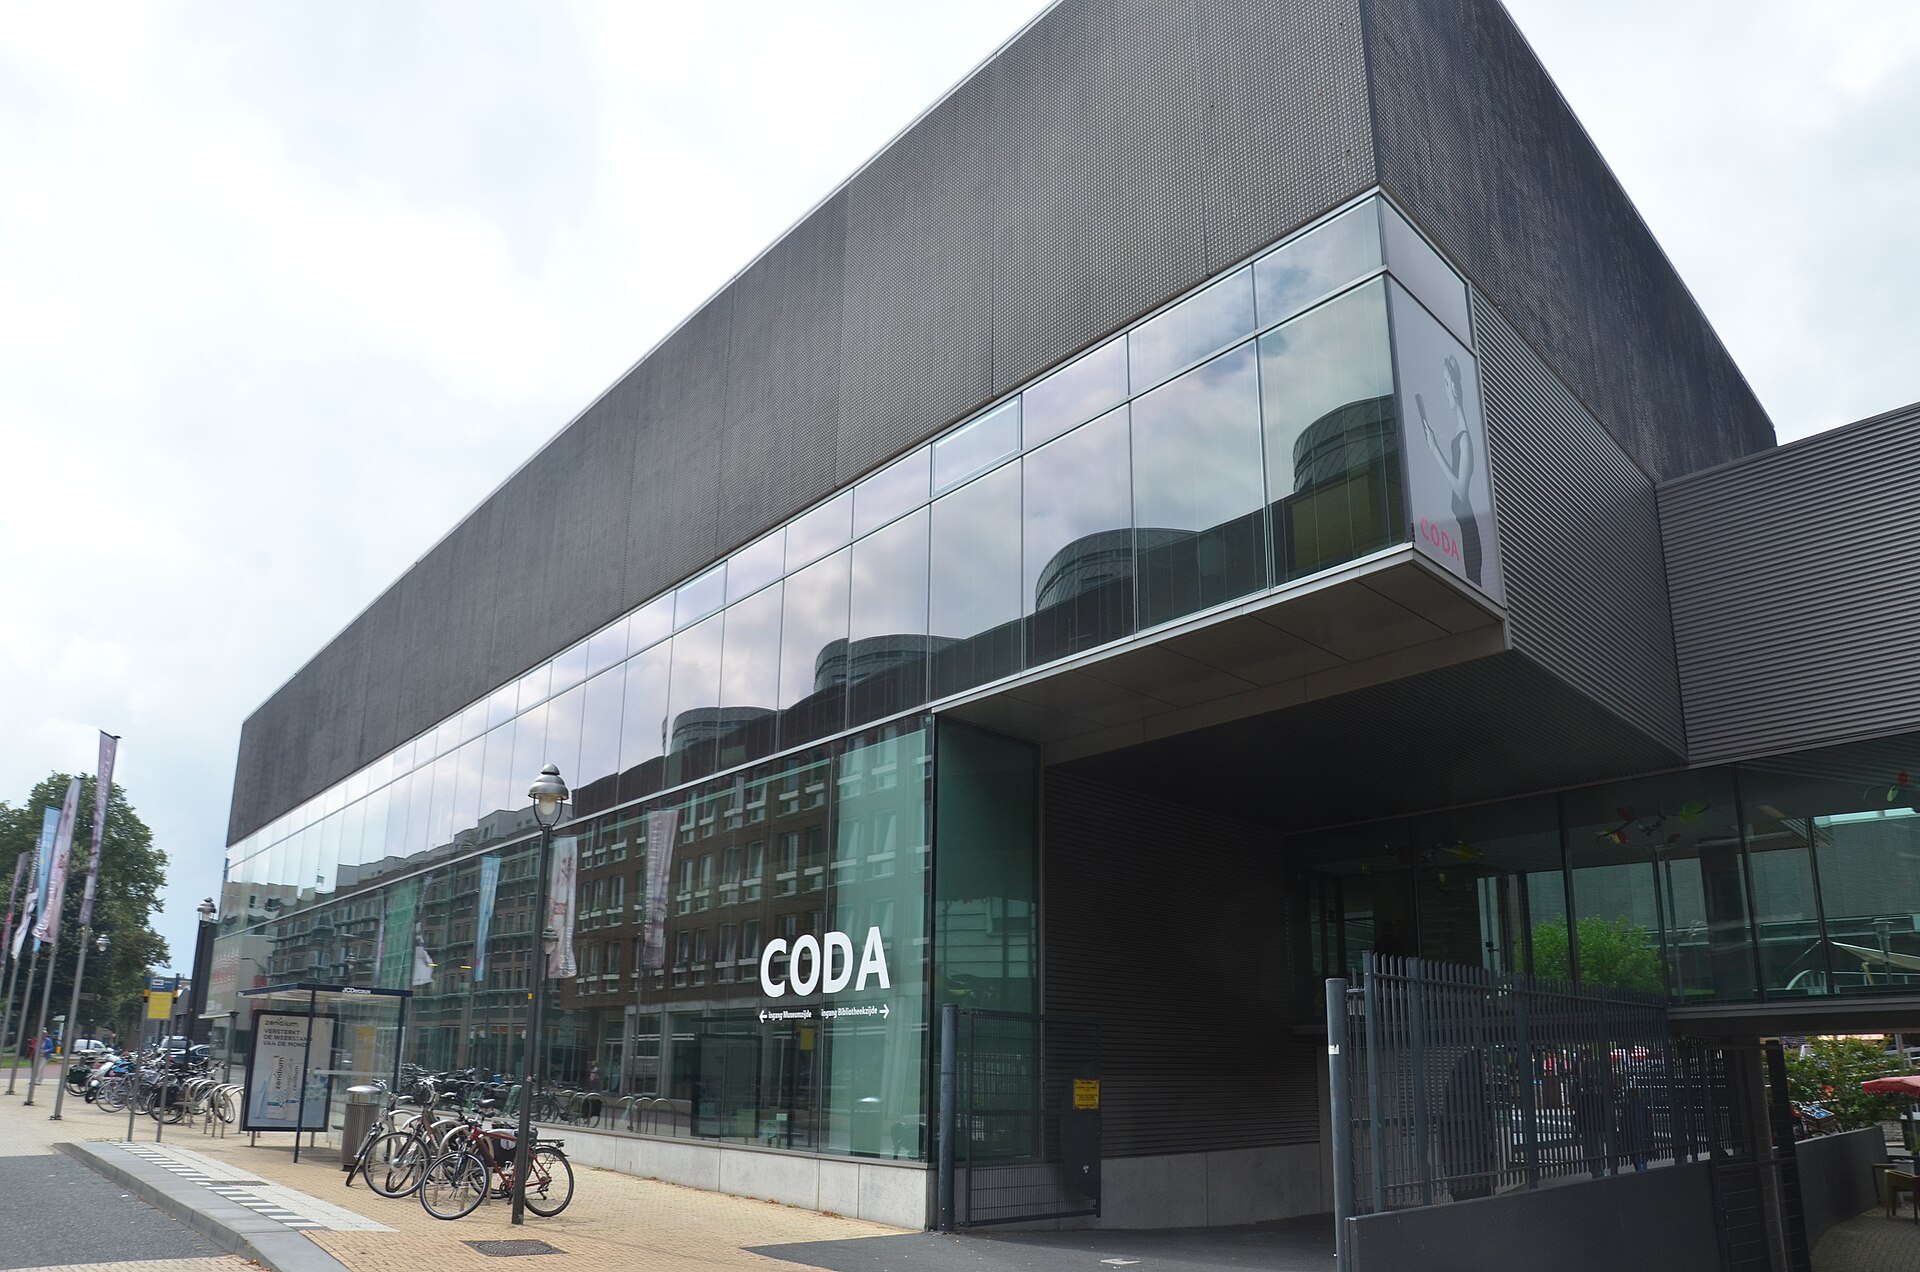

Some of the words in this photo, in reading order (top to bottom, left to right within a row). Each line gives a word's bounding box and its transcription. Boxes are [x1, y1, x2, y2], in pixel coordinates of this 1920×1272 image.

[1421, 518, 1460, 561] CODA
[761, 926, 890, 998] CODA
[837, 1005, 878, 1017] Bibliotheekzijde
